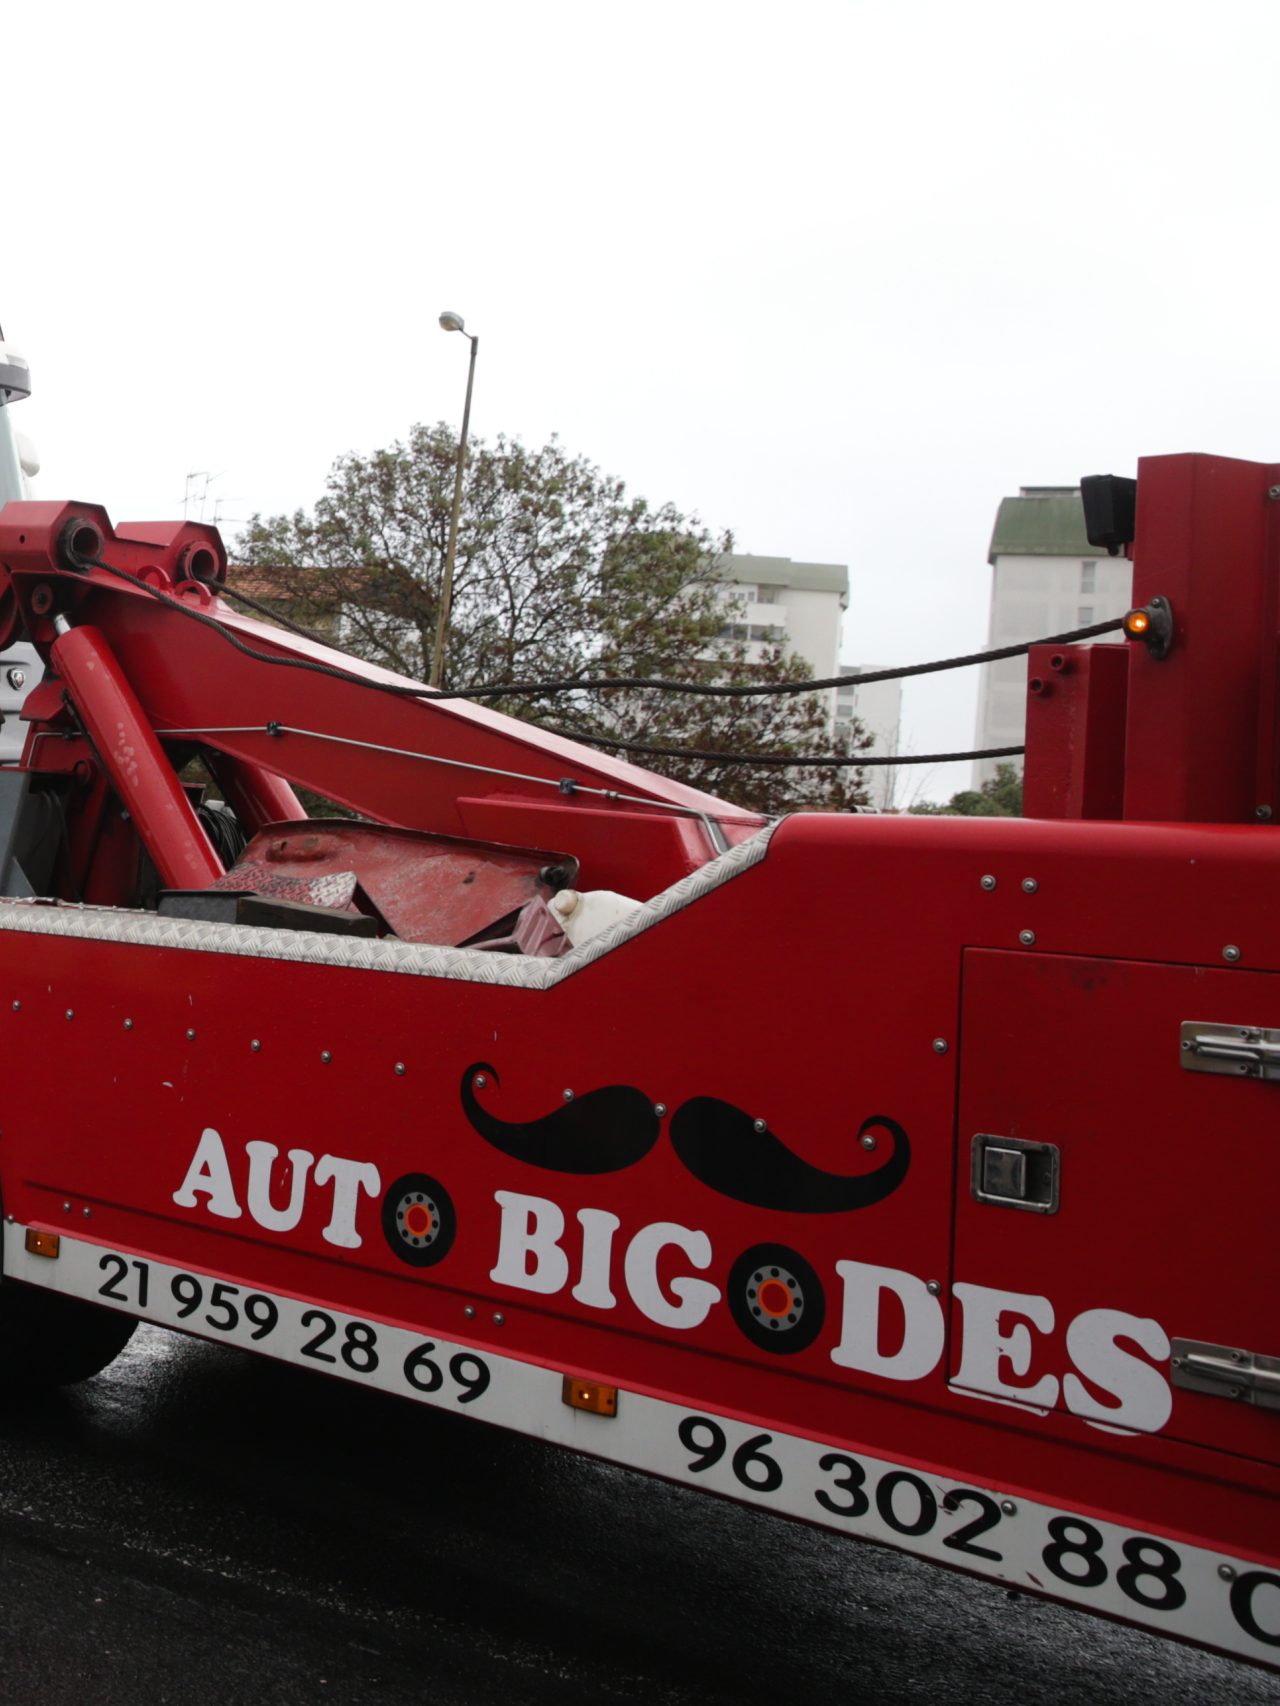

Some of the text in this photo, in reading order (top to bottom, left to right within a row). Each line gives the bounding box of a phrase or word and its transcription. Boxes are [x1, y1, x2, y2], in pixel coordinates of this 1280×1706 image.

[97, 1253, 492, 1405] 21 959 28 69
[677, 1415, 784, 1493] 96
[814, 1452, 1004, 1563] 302
[1041, 1515, 1188, 1611] 88
